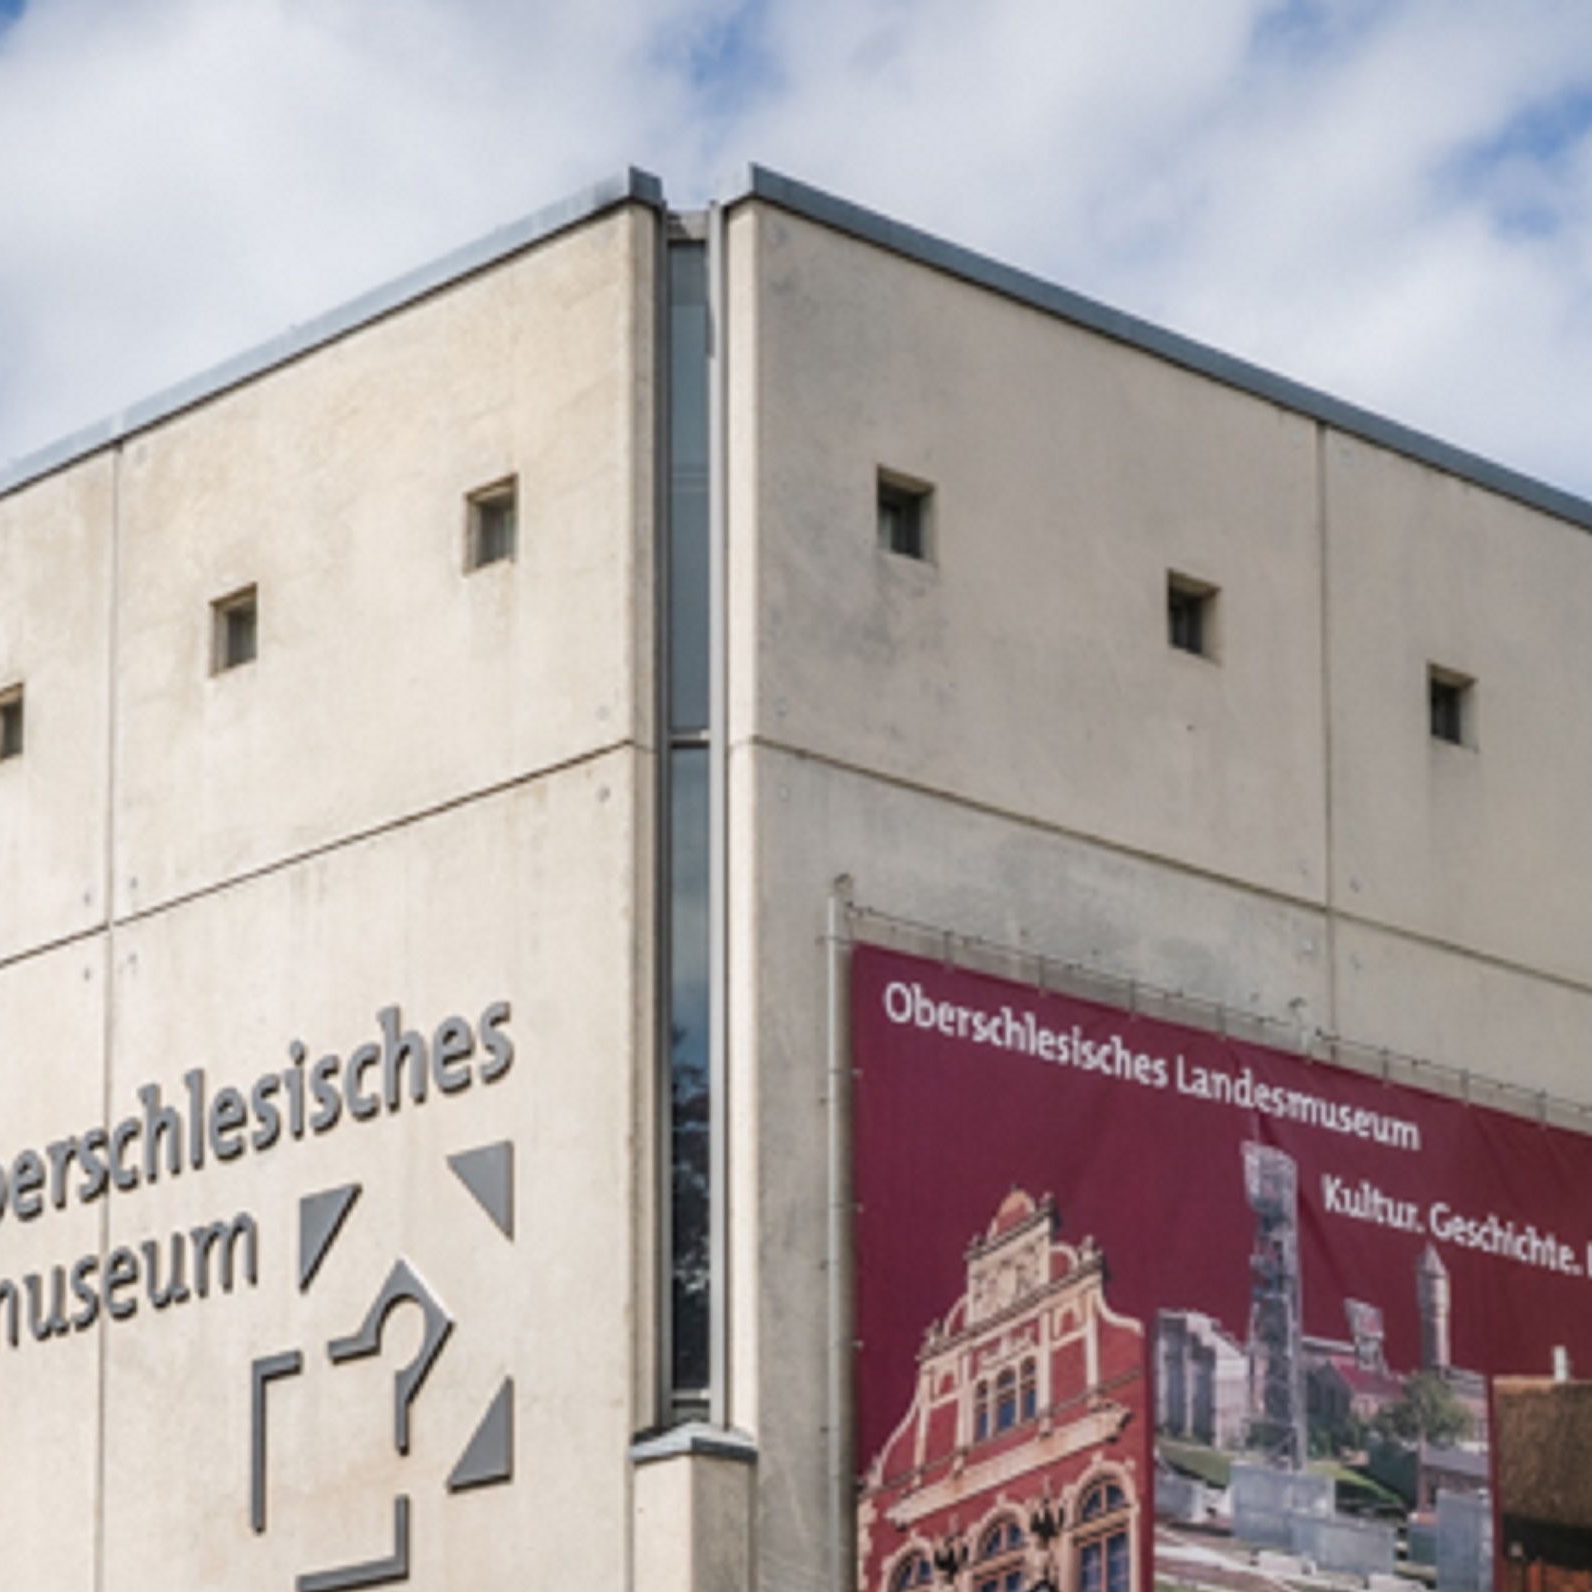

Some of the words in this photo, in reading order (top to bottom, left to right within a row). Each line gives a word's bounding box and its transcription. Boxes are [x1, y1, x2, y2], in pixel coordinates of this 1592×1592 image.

[882, 980, 1170, 1089] Oberschlesisches
[1175, 1053, 1422, 1152] Landesmuseum
[1321, 1173, 1427, 1235] Kultur.
[1429, 1200, 1584, 1276] Geschichte.
